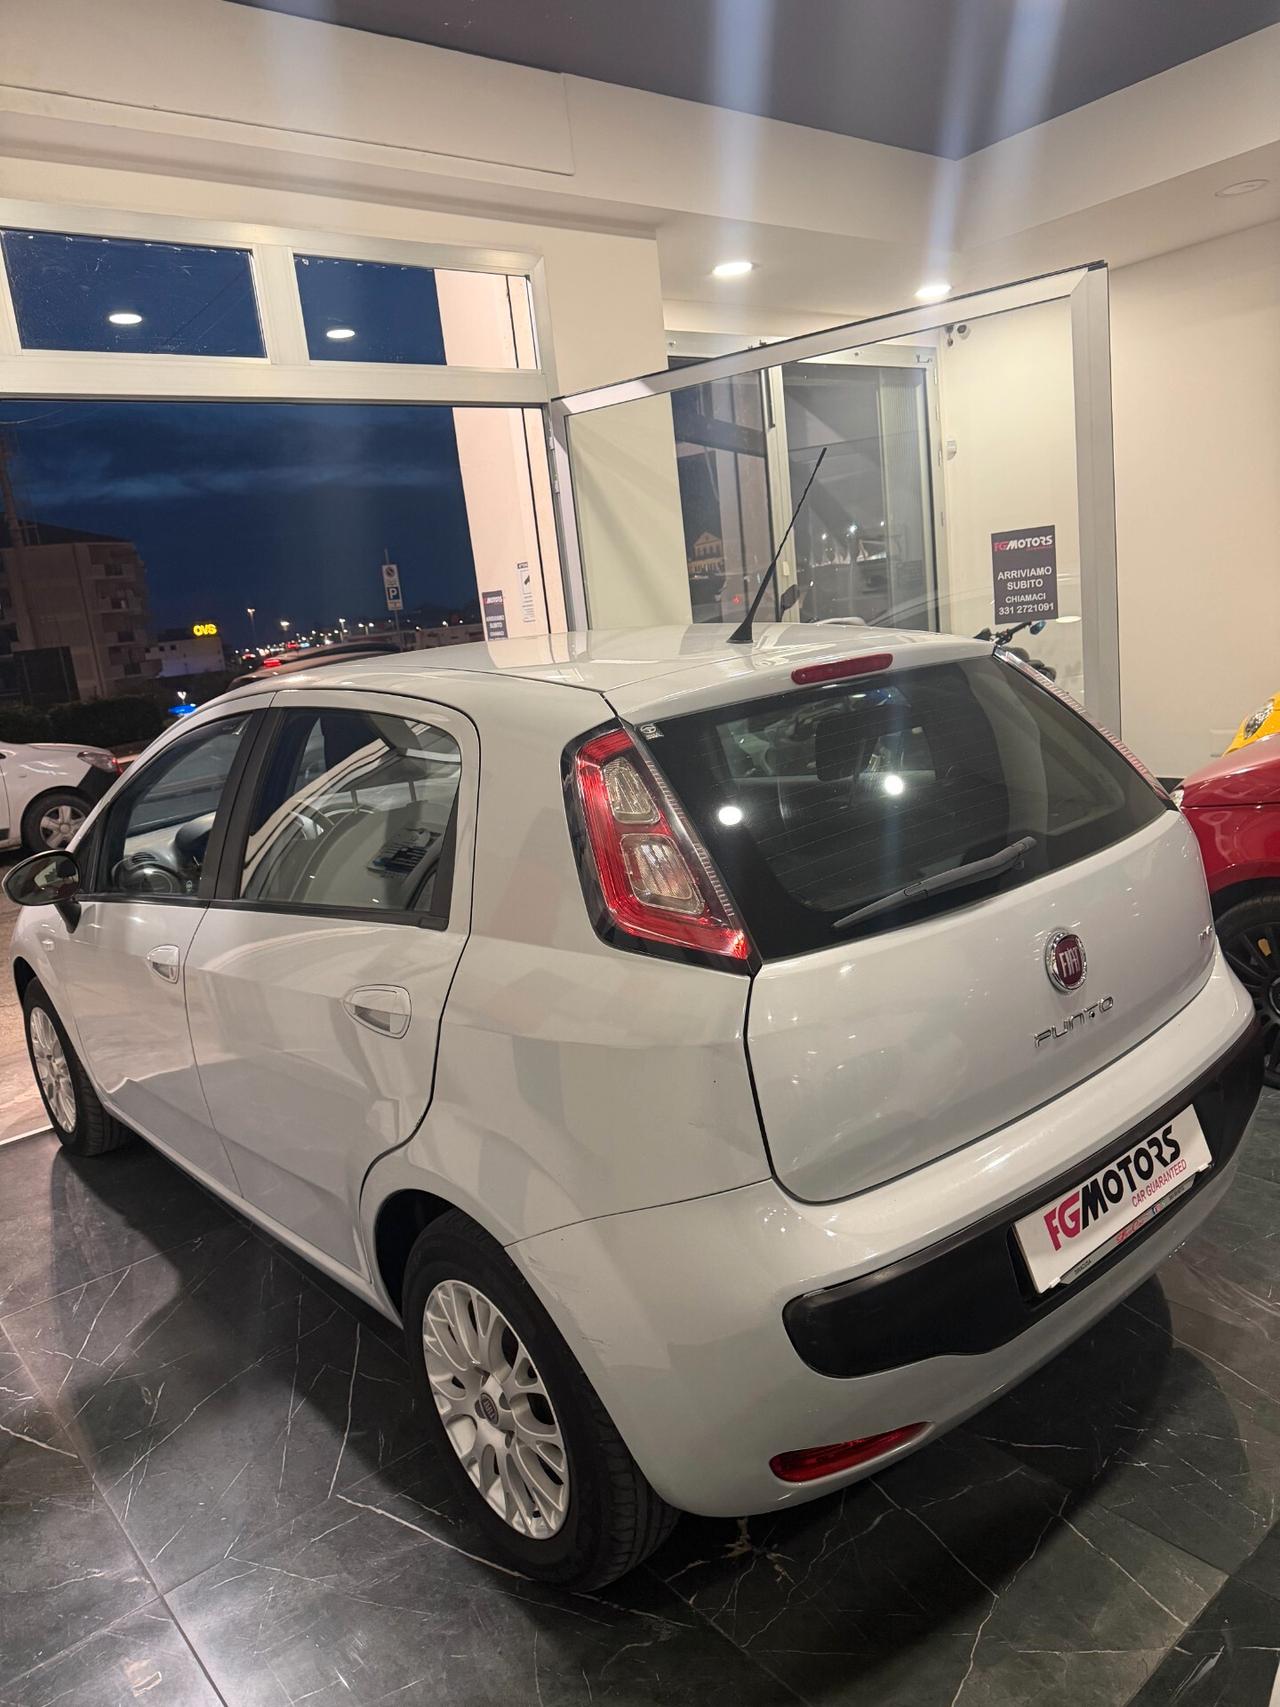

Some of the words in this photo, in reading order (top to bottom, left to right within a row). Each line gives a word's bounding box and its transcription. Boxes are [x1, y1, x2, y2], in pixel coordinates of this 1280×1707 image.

[998, 566, 1052, 580] ARRIVIAMO
[1007, 579, 1043, 590] SUBITO
[389, 588, 398, 600] P
[1005, 593, 1046, 603] CHIAMACI
[999, 606, 1014, 615] 331
[1017, 603, 1054, 613] 2721091
[193, 624, 217, 636] OVS
[1058, 946, 1079, 978] FIAT
[1034, 996, 1114, 1048] PUNTO
[1043, 1125, 1181, 1251] FGMOTORS
[1132, 1189, 1146, 1207] CAR
[1146, 1159, 1187, 1196] GUARANTEED
